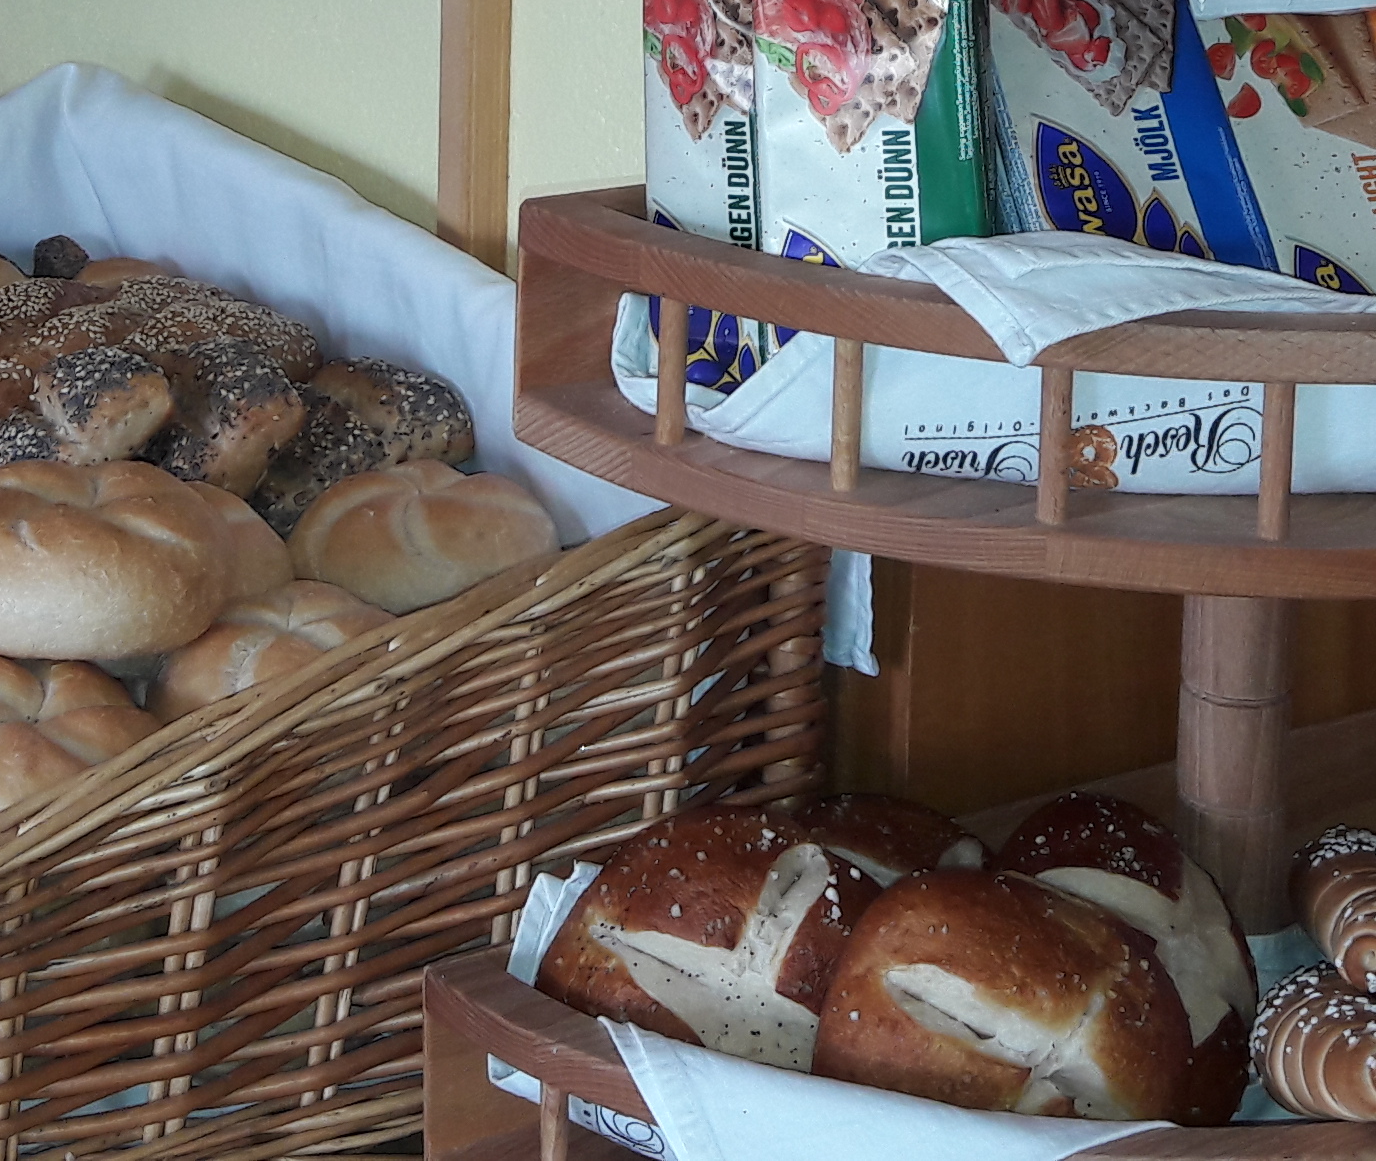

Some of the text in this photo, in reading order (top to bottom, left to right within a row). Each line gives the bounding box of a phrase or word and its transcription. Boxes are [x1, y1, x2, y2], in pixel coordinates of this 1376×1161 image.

[877, 129, 914, 200] DÜNN
[1130, 105, 1181, 182] MJÖLK
[721, 120, 752, 251] GEN DÜNN
[1120, 405, 1264, 475] Resch
